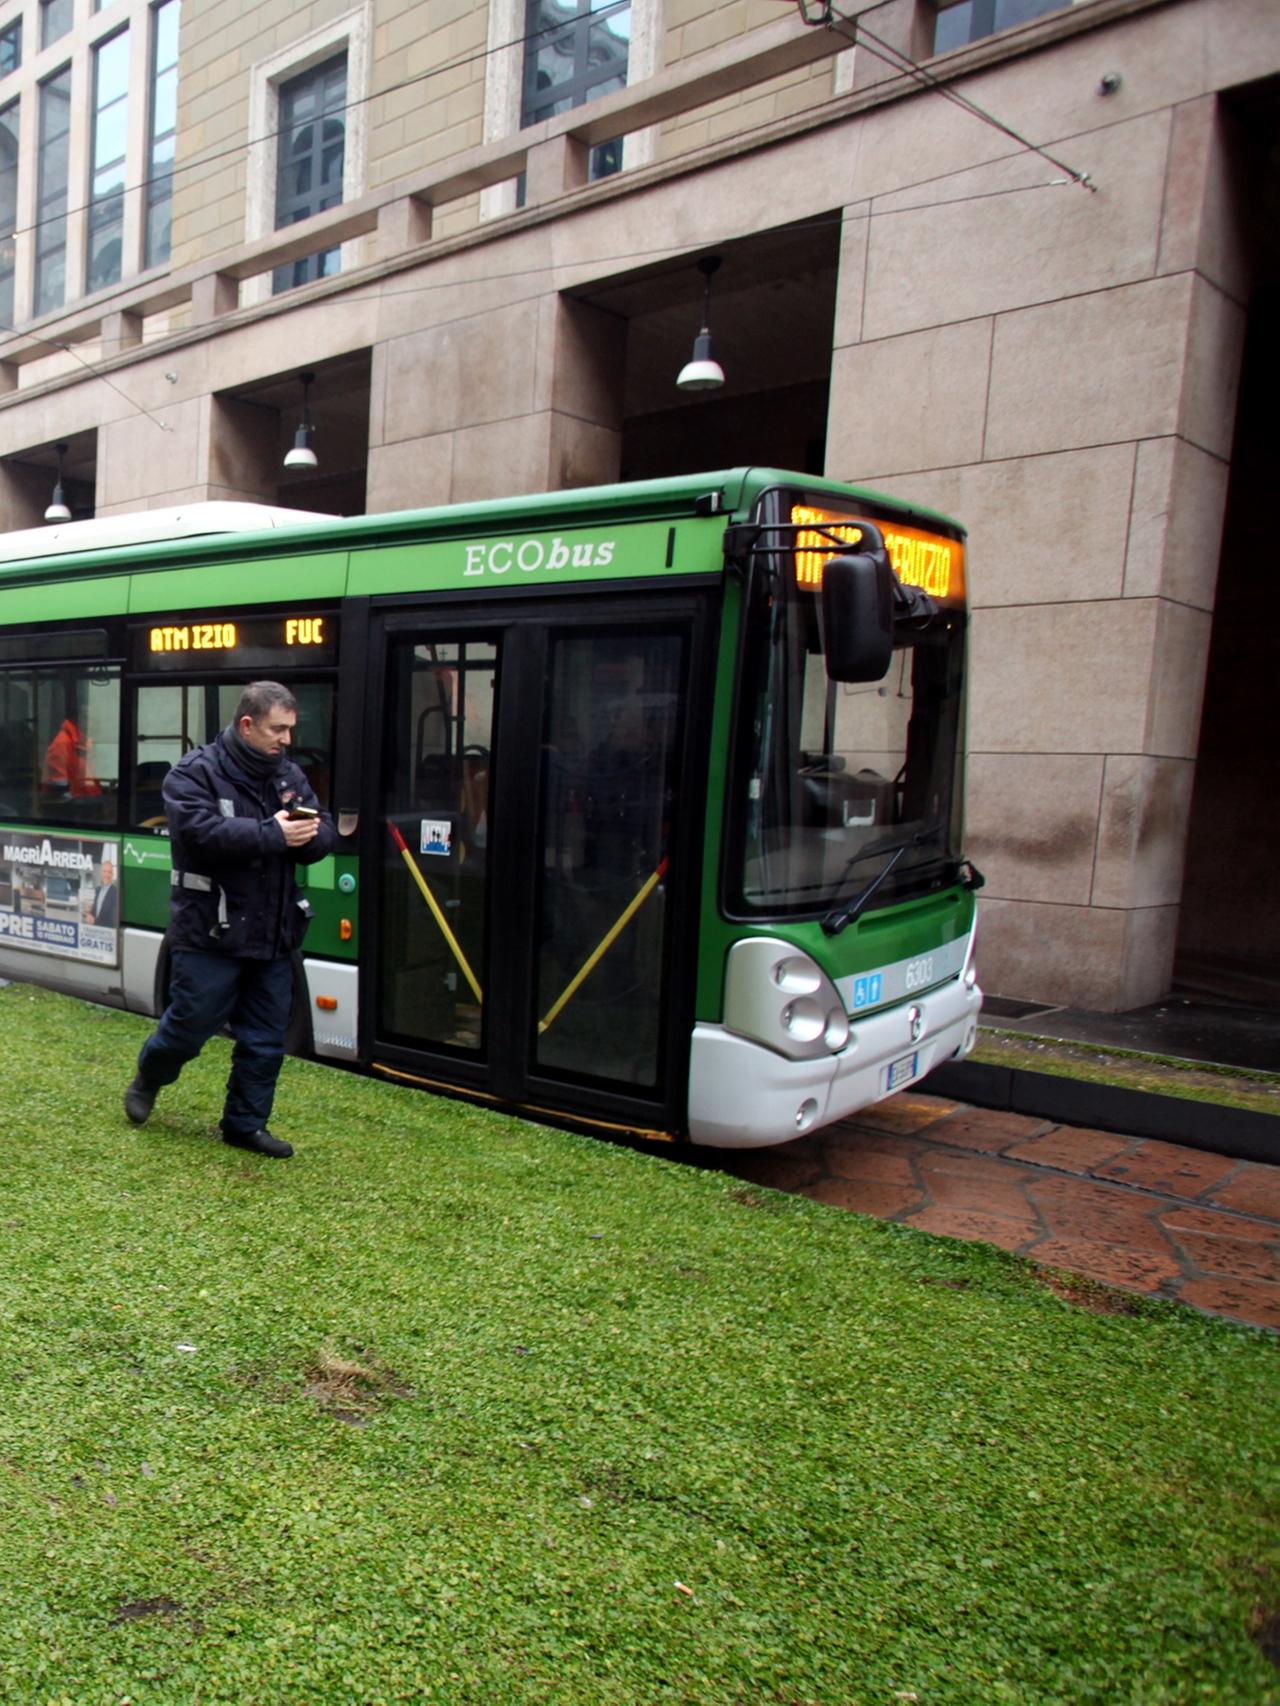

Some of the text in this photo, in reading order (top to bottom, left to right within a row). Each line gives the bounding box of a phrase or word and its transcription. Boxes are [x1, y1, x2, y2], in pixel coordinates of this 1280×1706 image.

[463, 536, 615, 578] ECObus
[150, 626, 189, 652] ATM
[36, 920, 75, 936] SABATO
[80, 937, 114, 953] GRATIS
[905, 956, 933, 990] 6303
